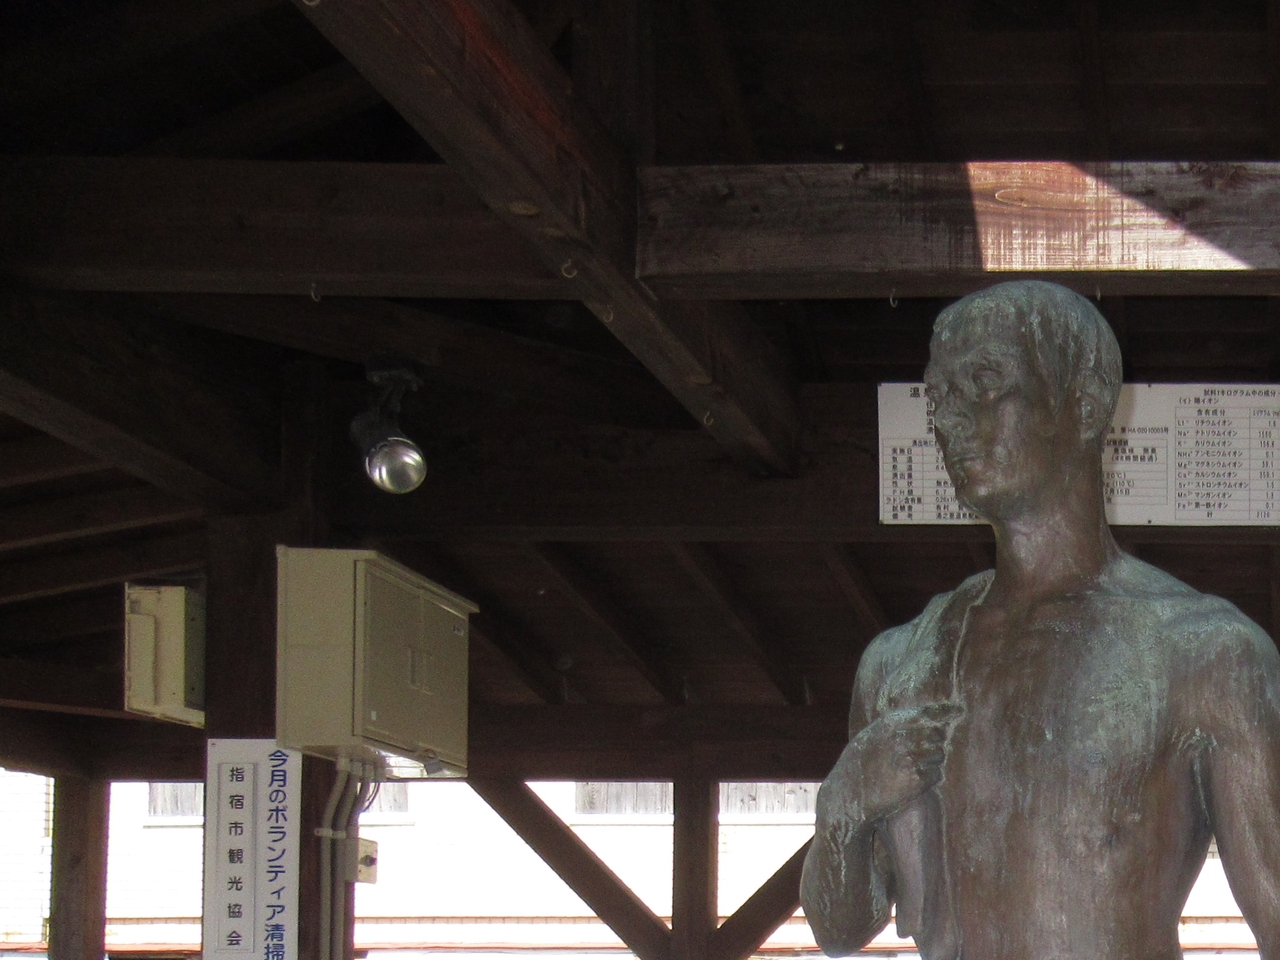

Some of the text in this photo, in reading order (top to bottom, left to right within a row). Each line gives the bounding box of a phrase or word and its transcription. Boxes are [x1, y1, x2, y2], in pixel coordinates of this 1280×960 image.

[226, 766, 245, 947] 指宿市観光協会
